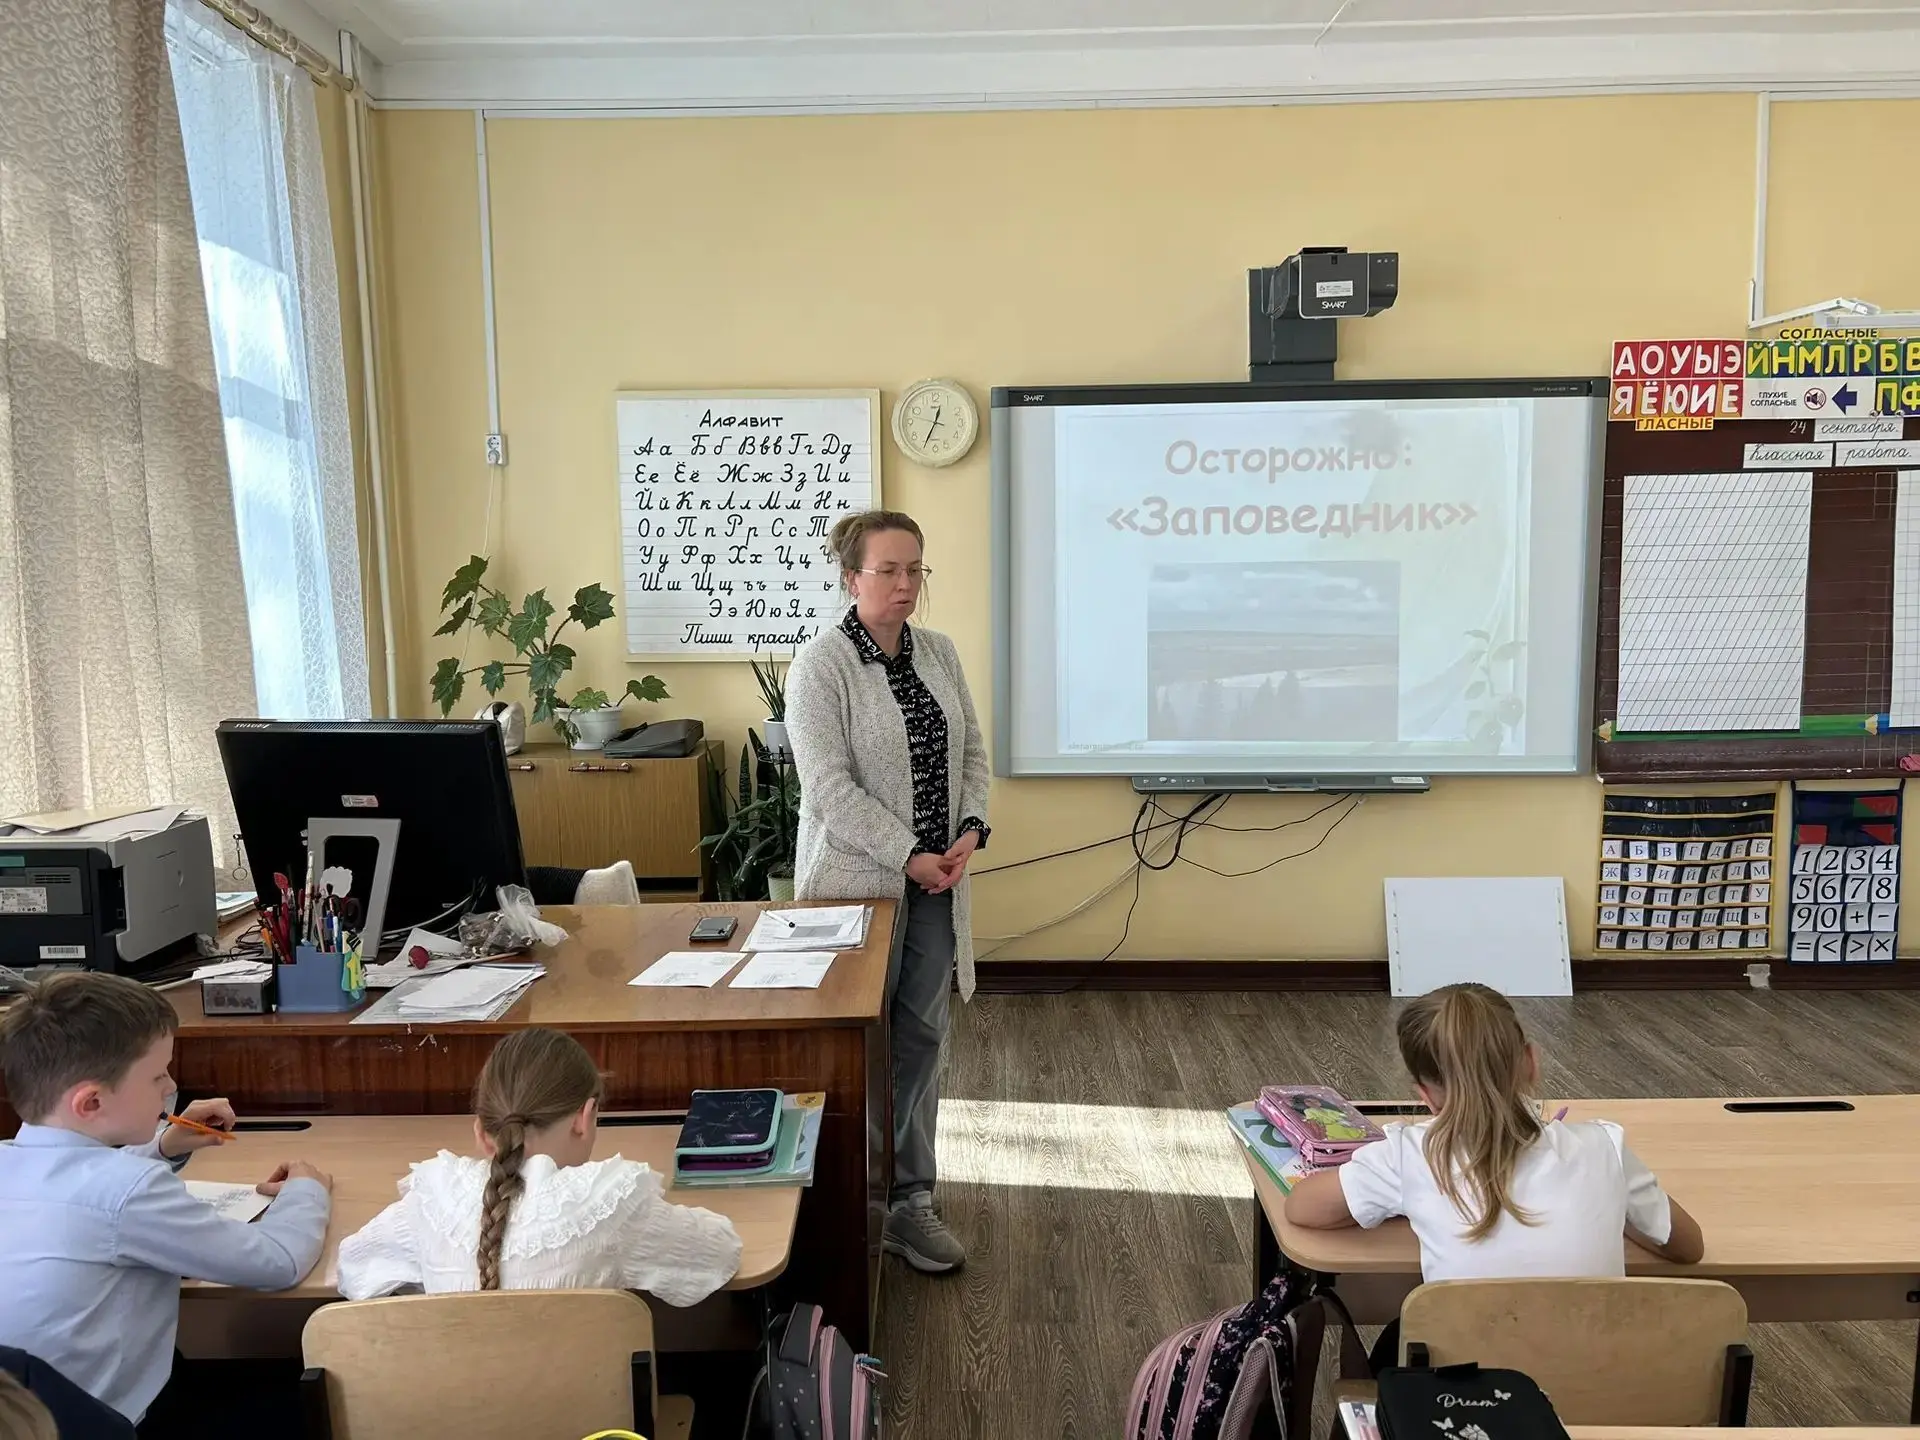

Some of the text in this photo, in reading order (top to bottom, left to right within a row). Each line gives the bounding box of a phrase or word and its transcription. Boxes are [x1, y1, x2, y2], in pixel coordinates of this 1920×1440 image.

[1321, 301, 1347, 309] SMART
[1779, 328, 1878, 340] СОГЛАСНЫЕ
[1023, 394, 1045, 402] SMART
[1759, 391, 1788, 399] ГЛУХИЕ
[1750, 399, 1797, 407] СОГЛАСНЫЕ
[1636, 417, 1713, 430] ГЛАСНЫЕ
[1165, 440, 1412, 483] Осторожно:
[1106, 496, 1478, 539] «Заповедник»
[680, 623, 733, 644] Пиши
[1606, 842, 1765, 857] А Б В Г Д Е Ё
[1798, 848, 1893, 872] 1 2 3 4
[1605, 865, 1766, 880] Ж З И Й К Л М
[1605, 888, 1765, 902] Н О П Р С Т У
[1796, 877, 1892, 899] 5 6 7 8
[1604, 911, 1615, 920] Ф
[1630, 912, 1640, 921] Х
[1656, 915, 1666, 924] Ц
[1681, 914, 1689, 924] Ч
[1704, 913, 1716, 922] Ш
[1726, 912, 1740, 922] Щ
[1797, 907, 1812, 928] 9
[1821, 907, 1837, 928] 0
[1654, 937, 1663, 945] Э
[1706, 935, 1714, 944] Я
[1436, 1393, 1498, 1408] Dream
